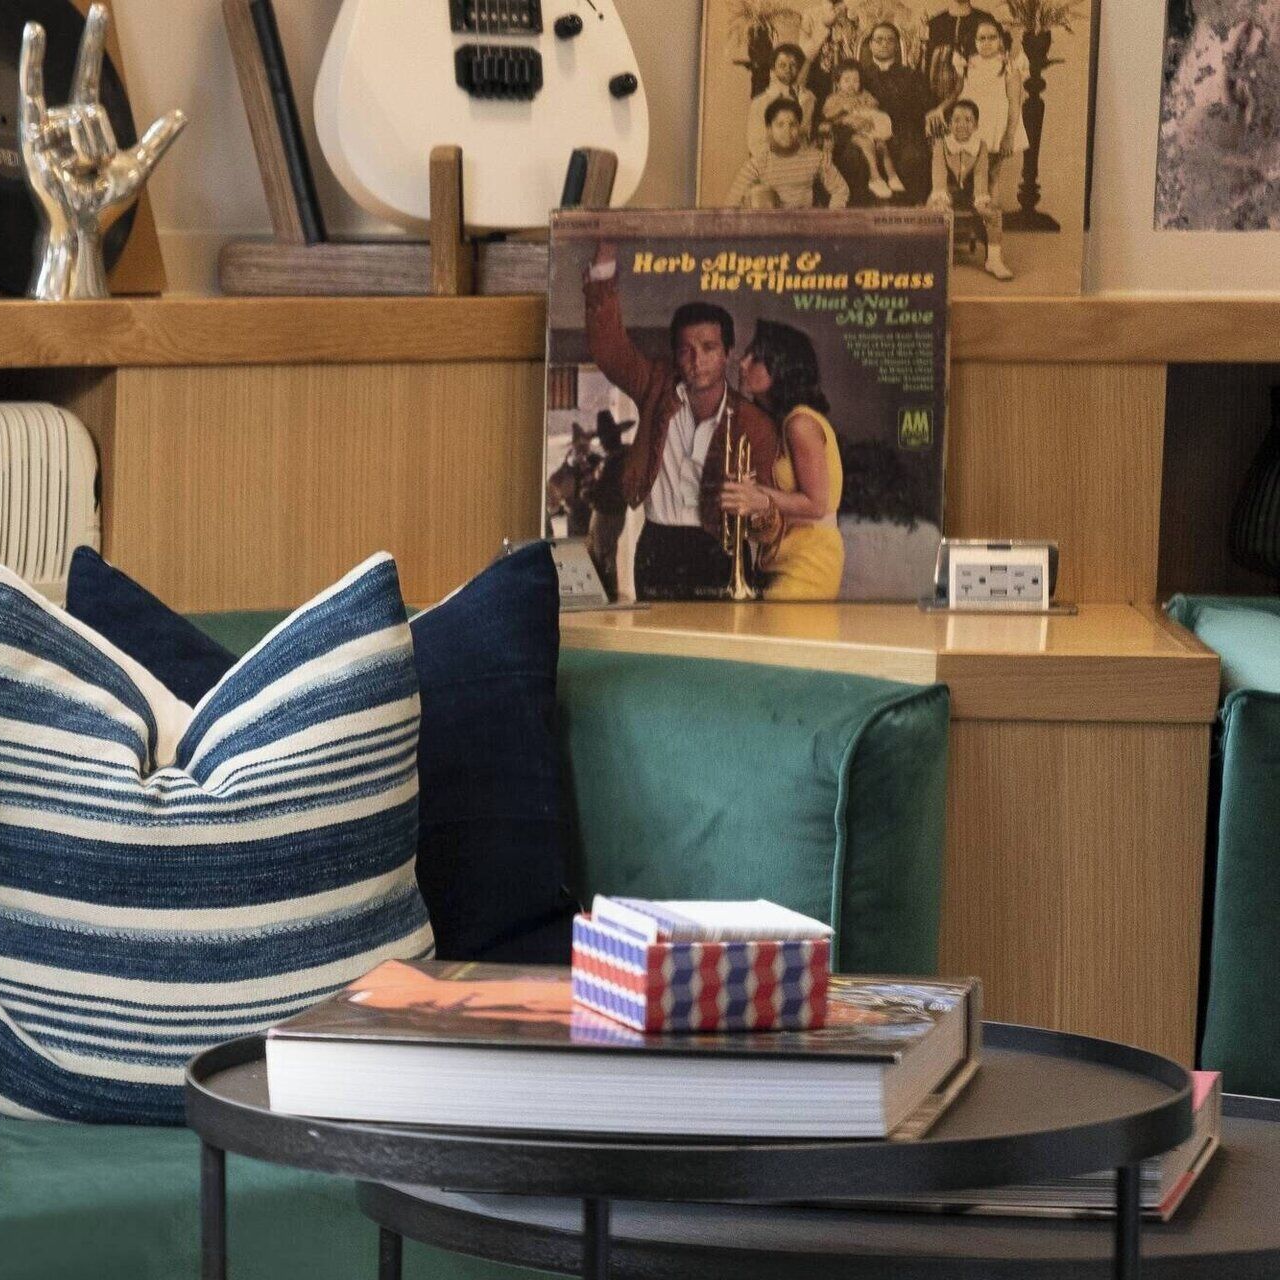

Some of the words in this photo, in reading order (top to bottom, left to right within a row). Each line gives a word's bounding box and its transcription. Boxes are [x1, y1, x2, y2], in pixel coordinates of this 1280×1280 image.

[633, 251, 696, 273] Herb
[701, 251, 790, 275] Alpert
[796, 250, 822, 272] &
[701, 270, 740, 291] the
[746, 269, 848, 294] Tijuana
[854, 268, 934, 290] Brass
[793, 293, 848, 310] What
[853, 293, 909, 310] Now
[836, 309, 878, 328] My
[885, 309, 934, 325] Love
